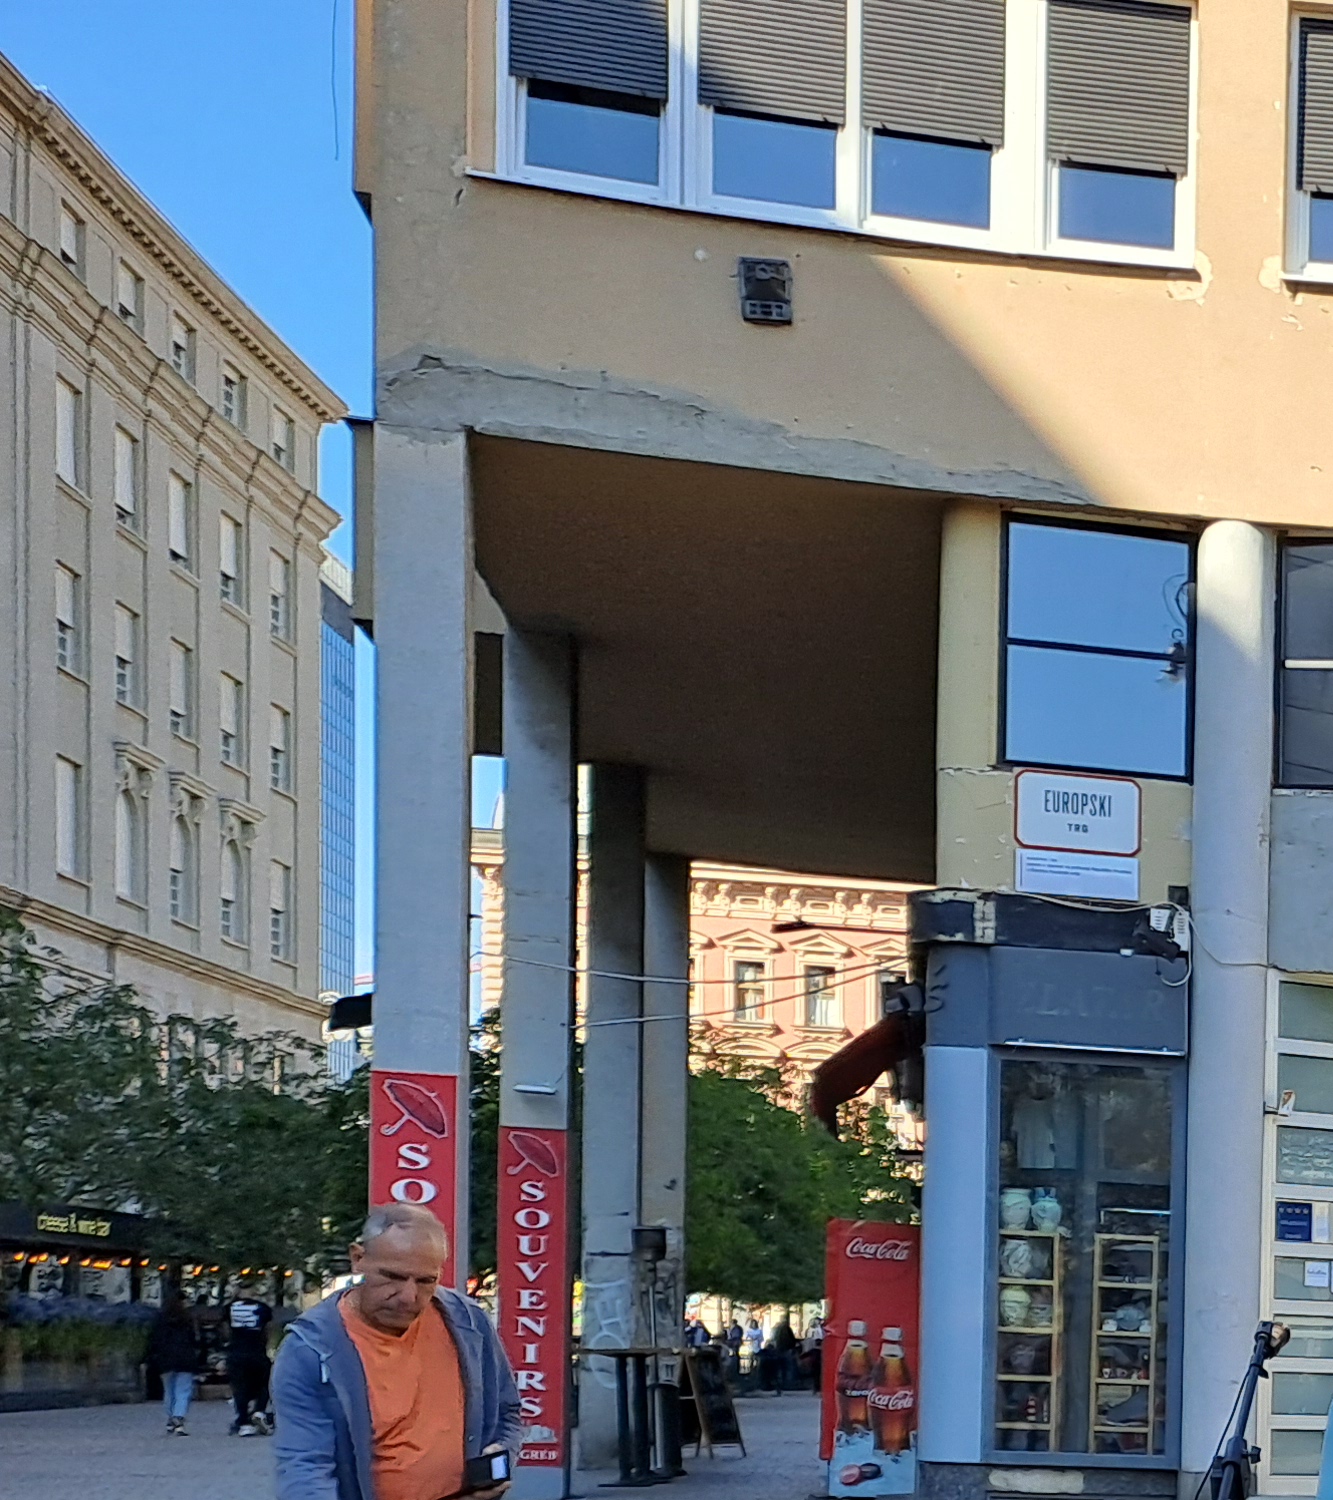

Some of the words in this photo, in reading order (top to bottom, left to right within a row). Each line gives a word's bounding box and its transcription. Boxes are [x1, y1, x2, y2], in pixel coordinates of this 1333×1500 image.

[1044, 789, 1112, 817] EUROPSKI
[1067, 823, 1089, 833] TRG
[513, 1180, 551, 1418] SOUVENIRS
